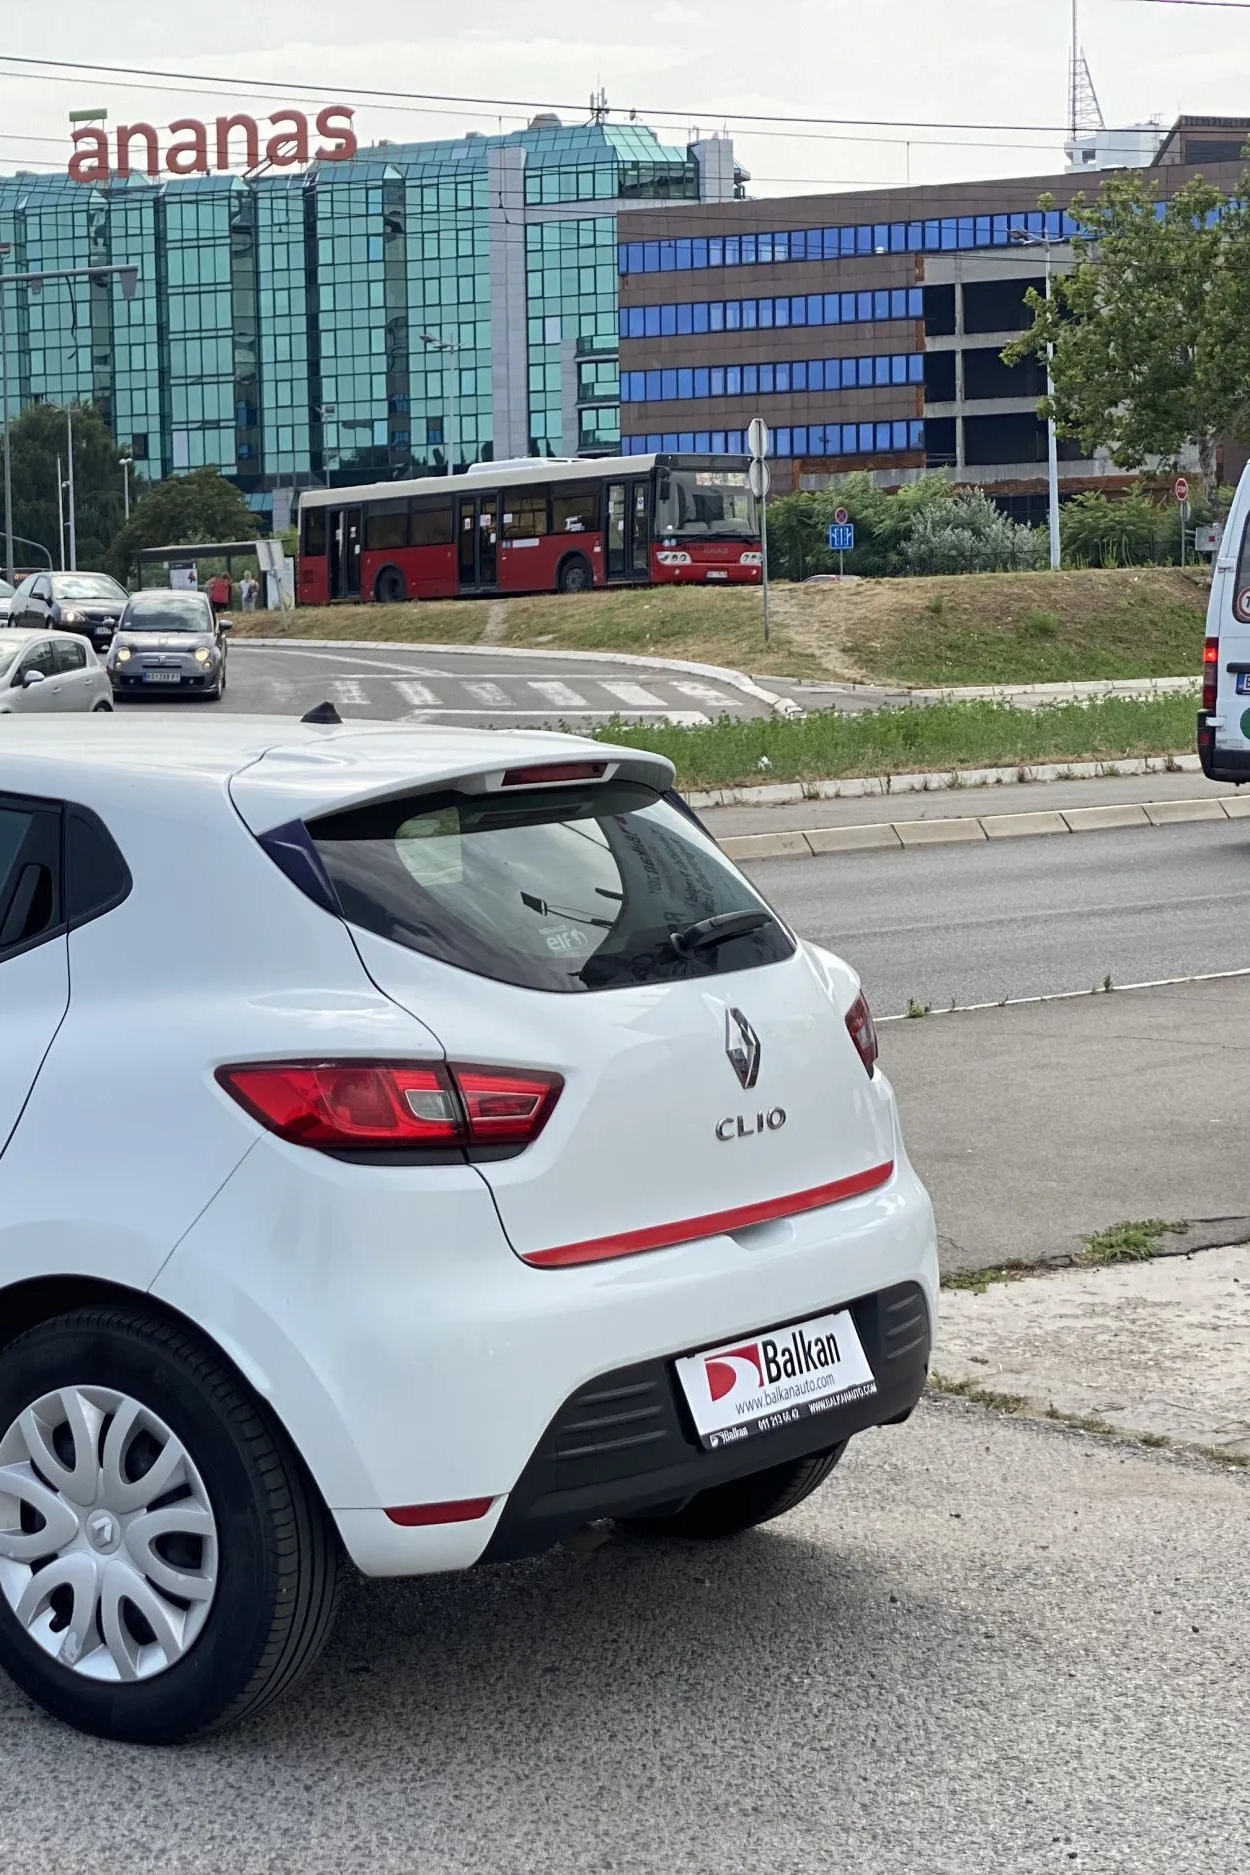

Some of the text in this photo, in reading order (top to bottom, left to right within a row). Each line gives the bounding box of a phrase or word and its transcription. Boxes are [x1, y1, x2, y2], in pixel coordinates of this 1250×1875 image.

[68, 105, 358, 183] ananas
[716, 1107, 786, 1141] CLIO
[761, 1329, 841, 1385] Balkan
[735, 1373, 835, 1416] www.balkanauto.com
[724, 1427, 748, 1443] Balkan
